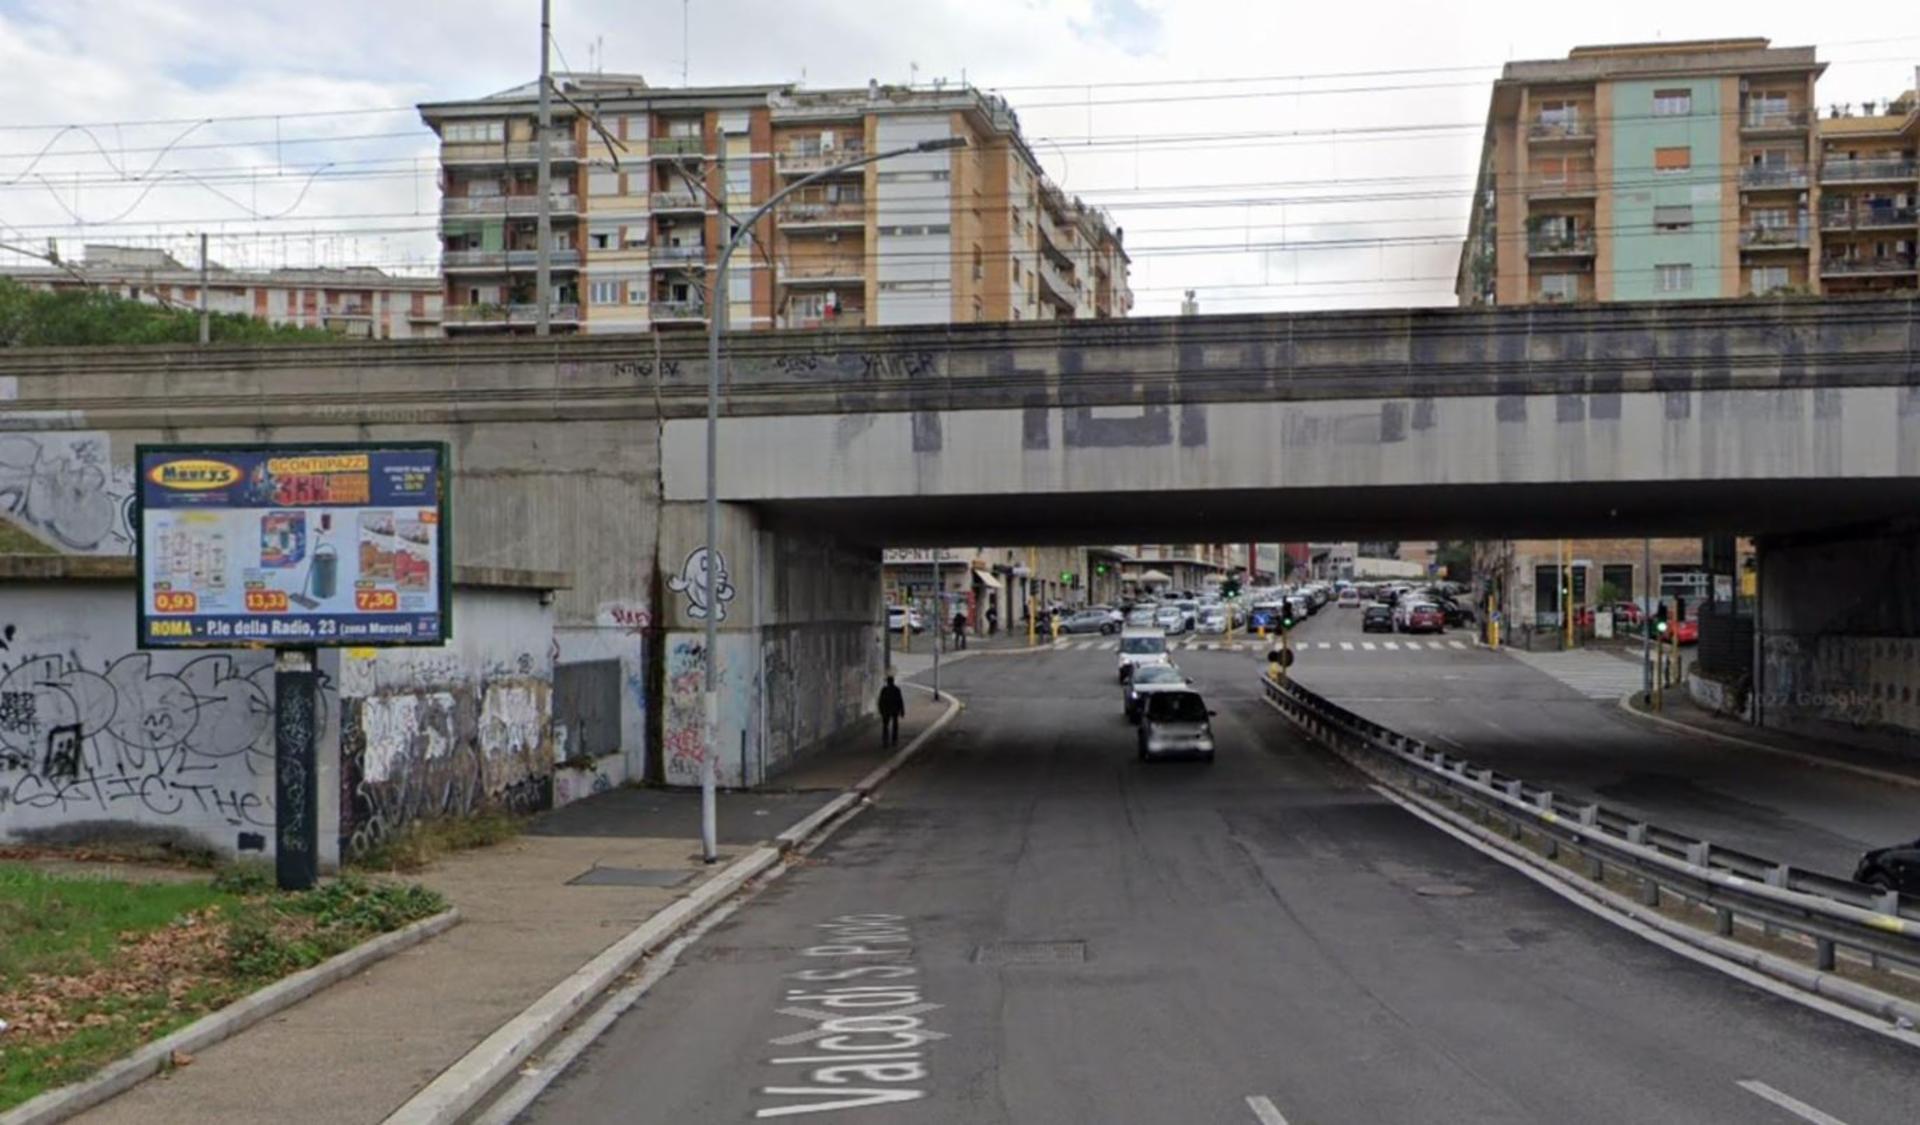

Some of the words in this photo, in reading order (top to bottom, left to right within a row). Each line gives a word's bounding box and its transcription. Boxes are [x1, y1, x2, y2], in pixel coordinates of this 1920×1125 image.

[157, 594, 194, 611] 0,93
[247, 593, 287, 609] 13,33
[358, 592, 394, 609] 7,36
[150, 621, 192, 636] ROMA
[206, 621, 231, 636] P.le
[234, 620, 268, 636] della
[271, 619, 314, 637] Radio,
[318, 619, 336, 635] 23
